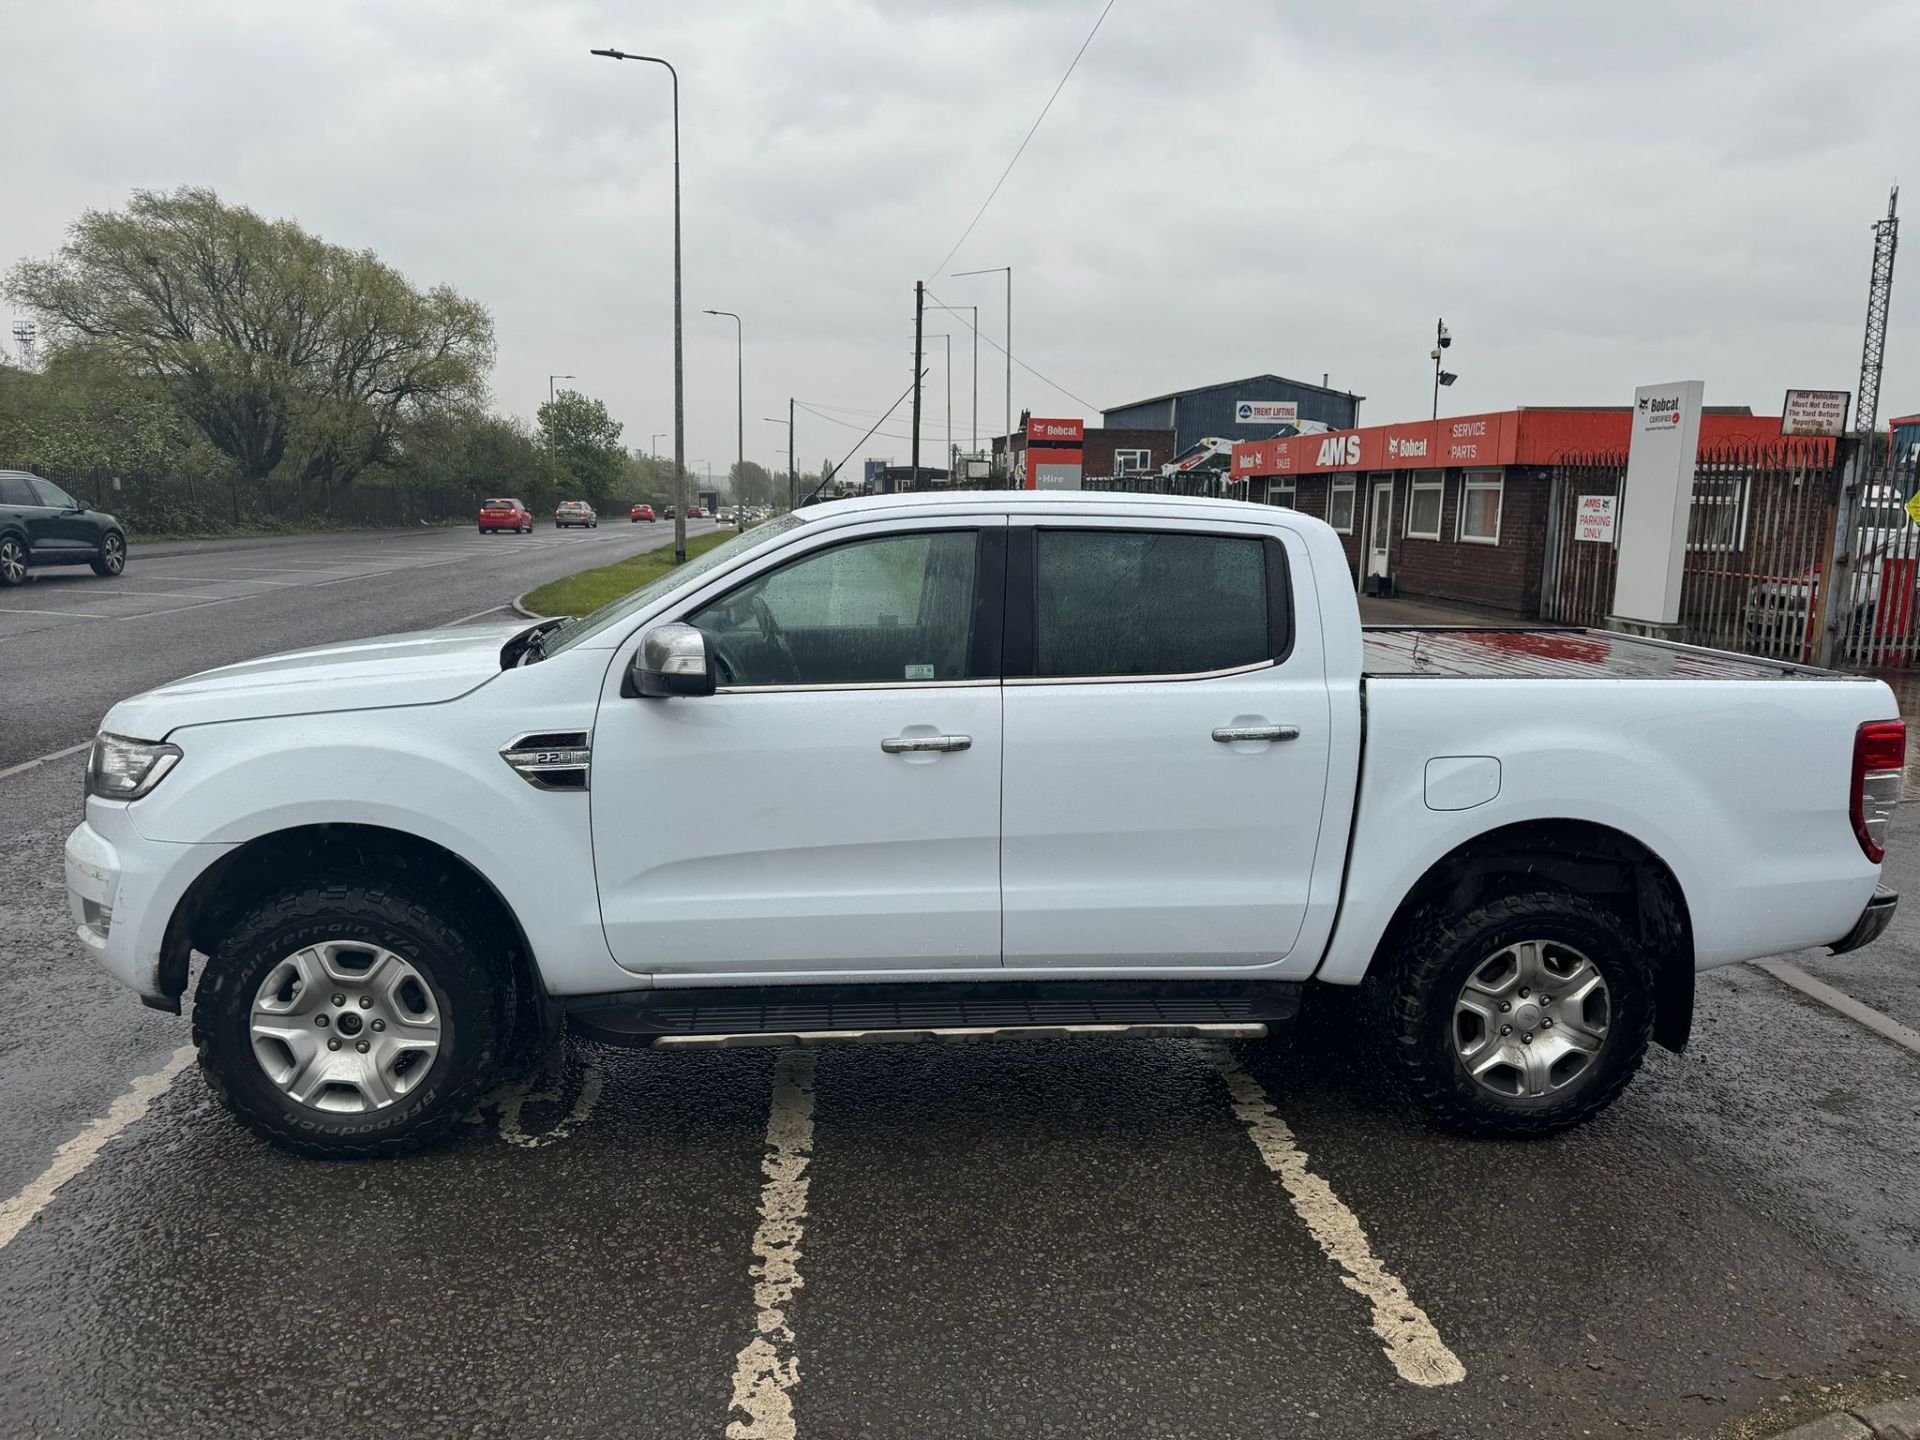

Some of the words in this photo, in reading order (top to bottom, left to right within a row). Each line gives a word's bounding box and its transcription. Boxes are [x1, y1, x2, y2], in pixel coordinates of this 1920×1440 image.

[1812, 392, 1839, 400] Vehicles
[1651, 396, 1679, 412] Bobcat
[1254, 407, 1272, 417] TRENT
[1273, 407, 1295, 417] LIFTING
[1792, 419, 1823, 427] Reporting
[1047, 425, 1077, 436] Bobcat
[1452, 421, 1486, 438] SERVICE
[1315, 434, 1360, 467] AMS
[1400, 437, 1427, 457] Bobcat
[1451, 444, 1477, 459] PARTS
[1240, 454, 1255, 469] Bobcat
[1275, 458, 1290, 469] SALES
[1042, 474, 1065, 483] Hire
[1583, 498, 1601, 508] AMS
[1579, 514, 1611, 527] PARKING
[1583, 527, 1603, 539] ONLY
